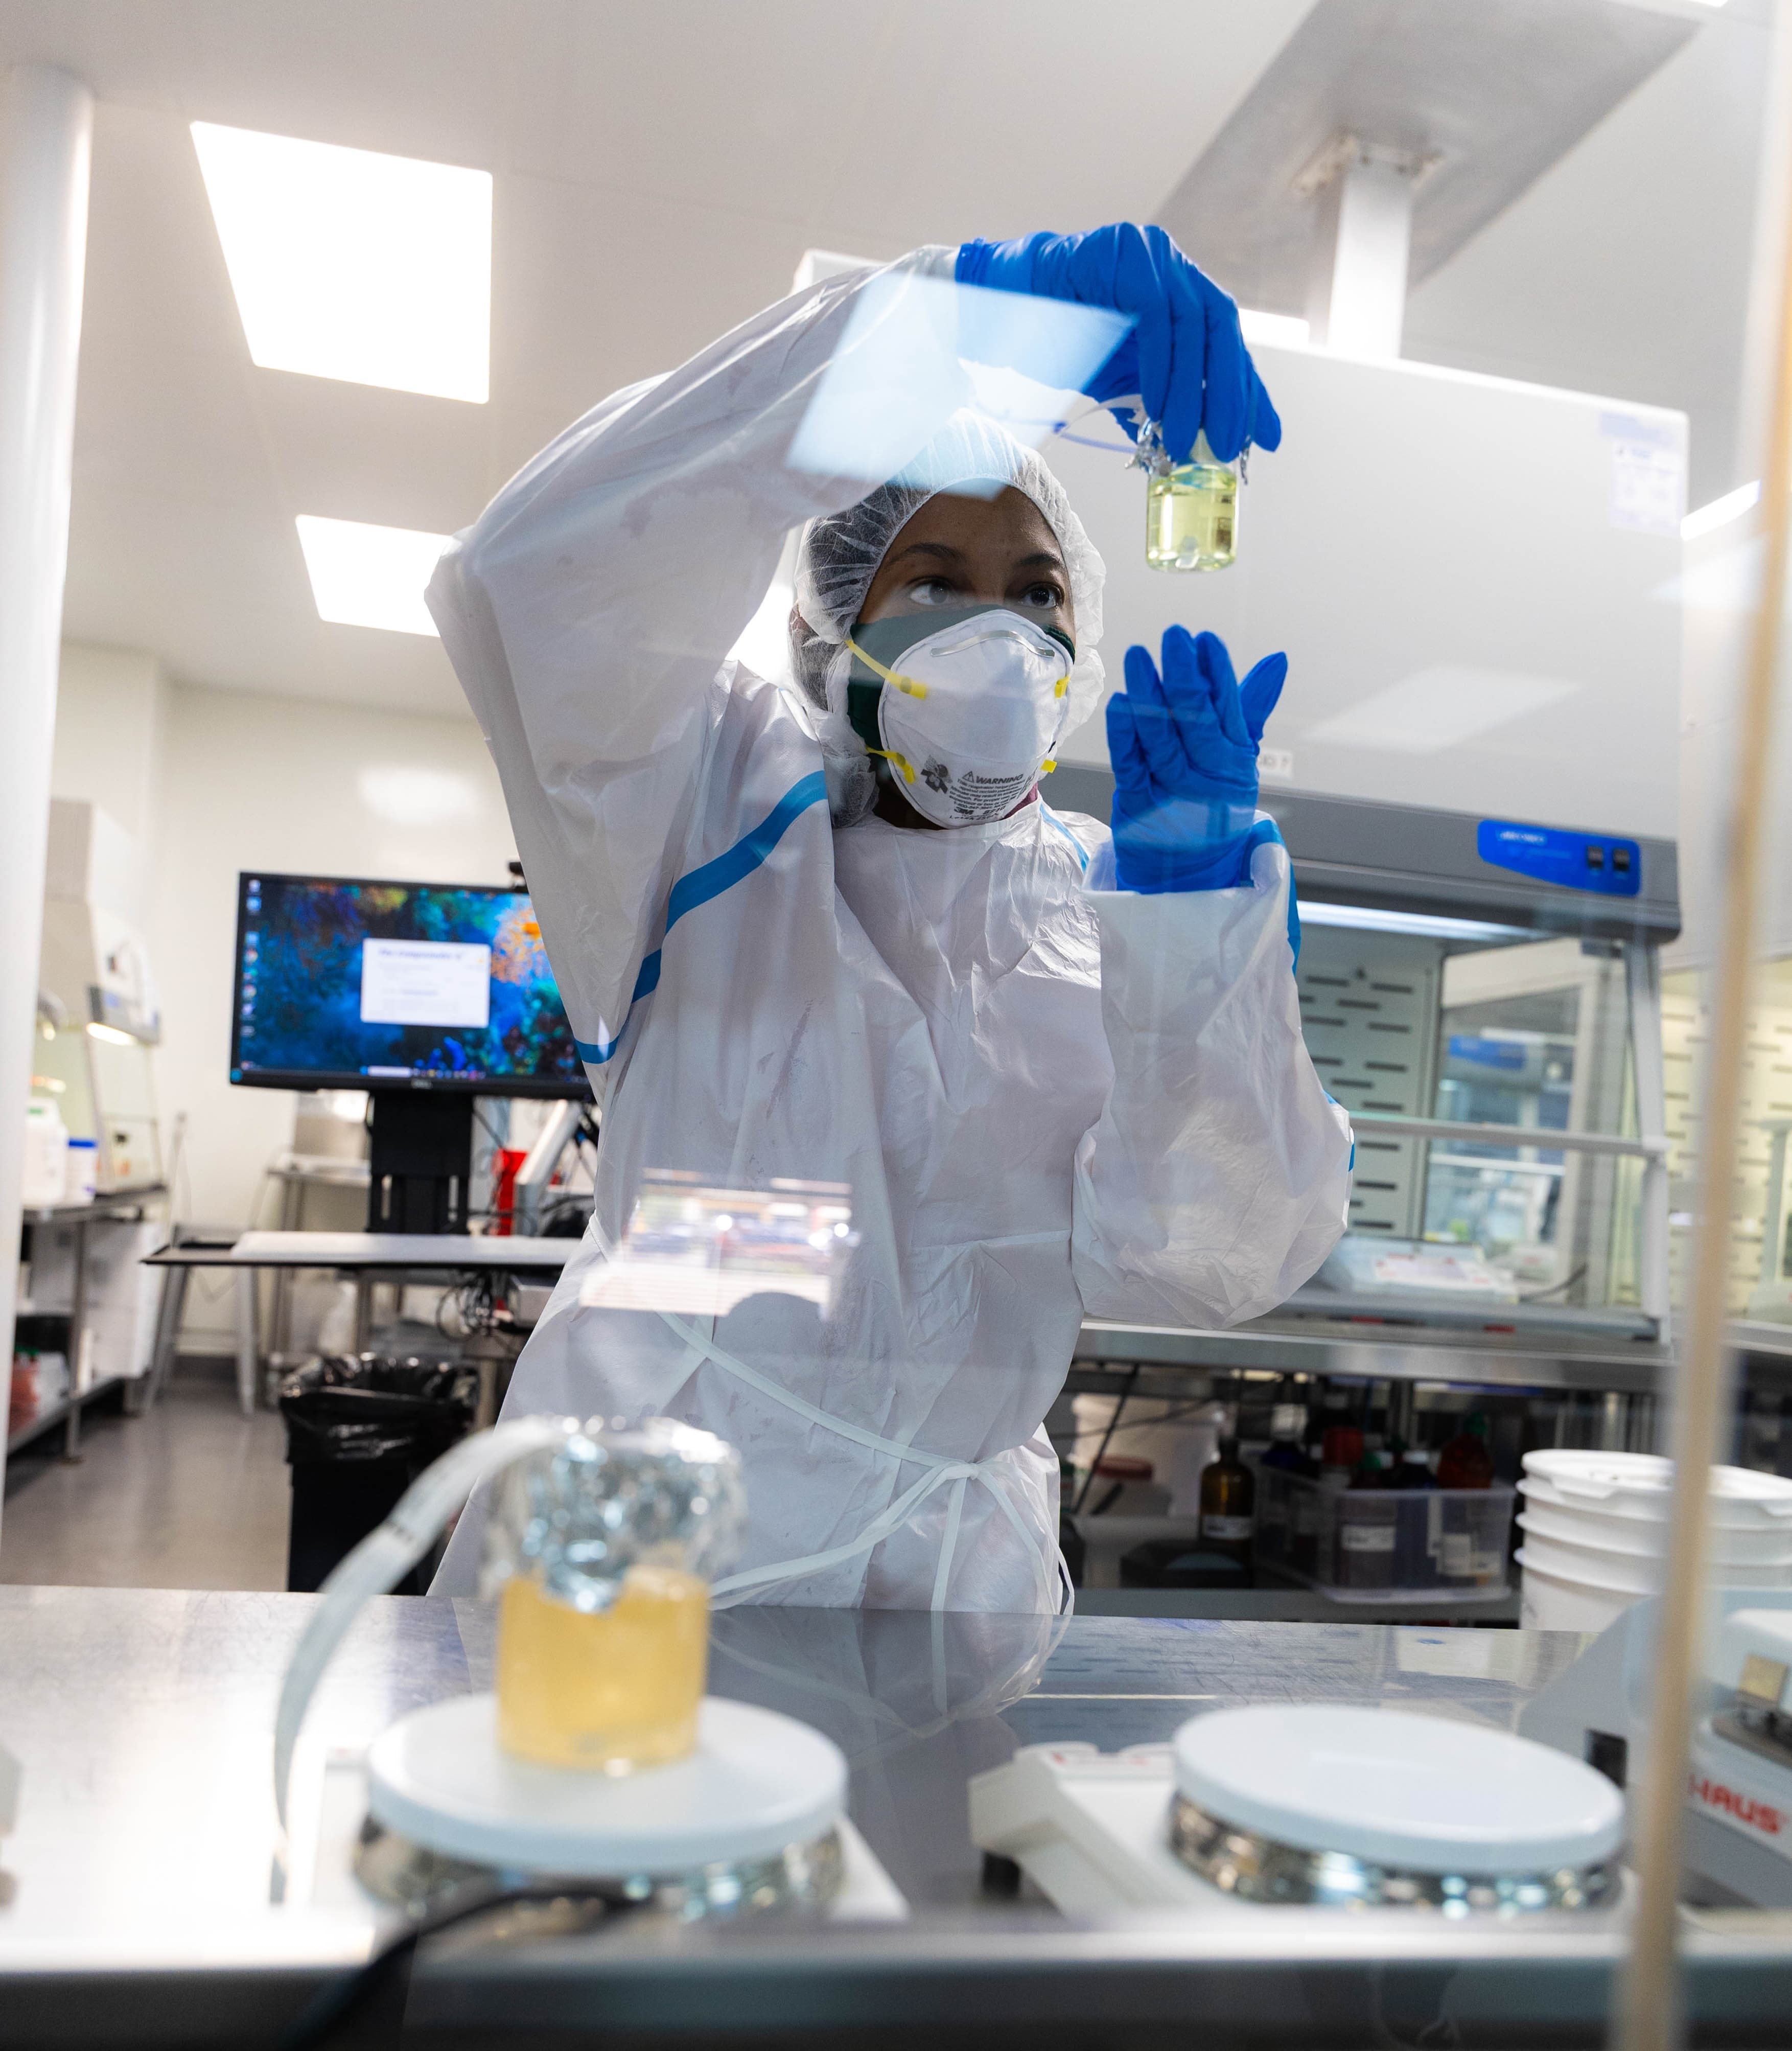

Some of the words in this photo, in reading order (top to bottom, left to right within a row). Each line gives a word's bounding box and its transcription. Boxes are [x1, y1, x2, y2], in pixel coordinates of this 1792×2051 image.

[976, 774, 1023, 784] WARNING
[953, 806, 973, 815] 3M
[1687, 1773, 1781, 1835] HAUS
